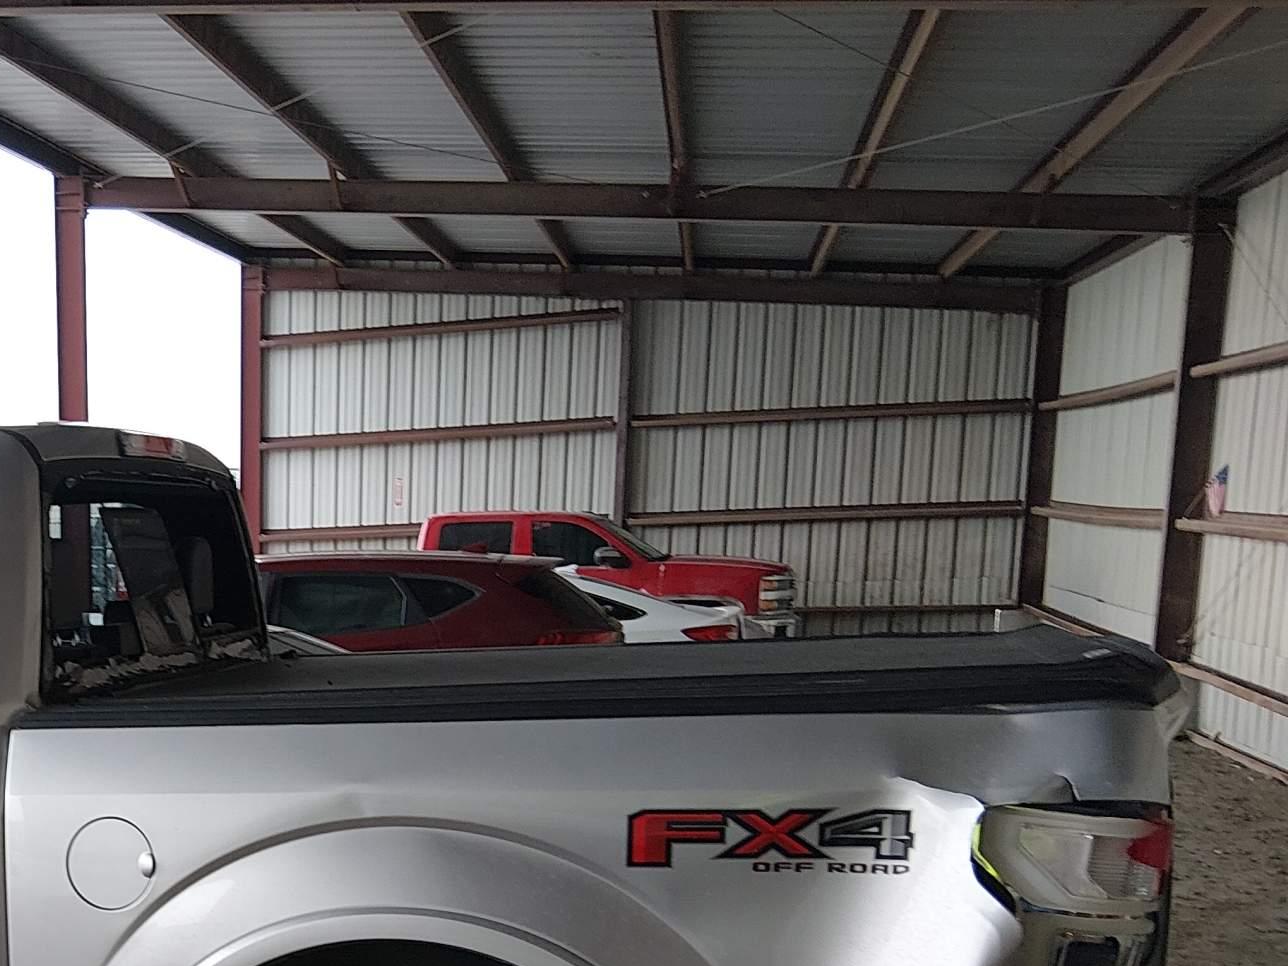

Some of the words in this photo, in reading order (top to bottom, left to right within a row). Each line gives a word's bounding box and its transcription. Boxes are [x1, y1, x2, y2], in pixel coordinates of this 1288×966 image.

[626, 808, 914, 868] FX4
[752, 862, 814, 873] OFF
[827, 862, 910, 875] ROAD
